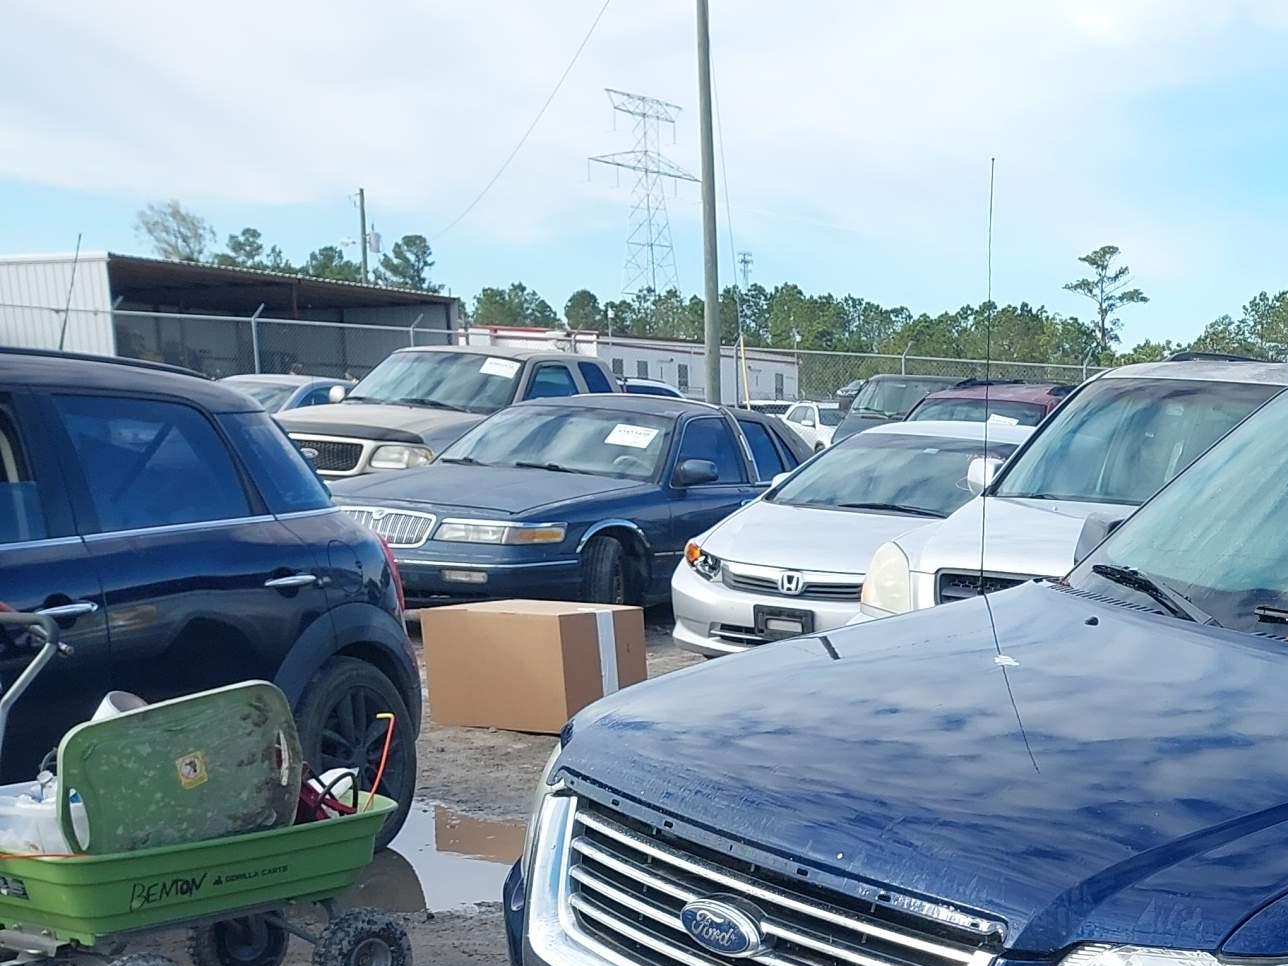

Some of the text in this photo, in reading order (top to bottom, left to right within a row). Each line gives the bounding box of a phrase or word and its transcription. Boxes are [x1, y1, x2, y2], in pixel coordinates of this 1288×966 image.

[225, 864, 288, 884] GORILLA CARTS
[692, 910, 736, 946] Ford
